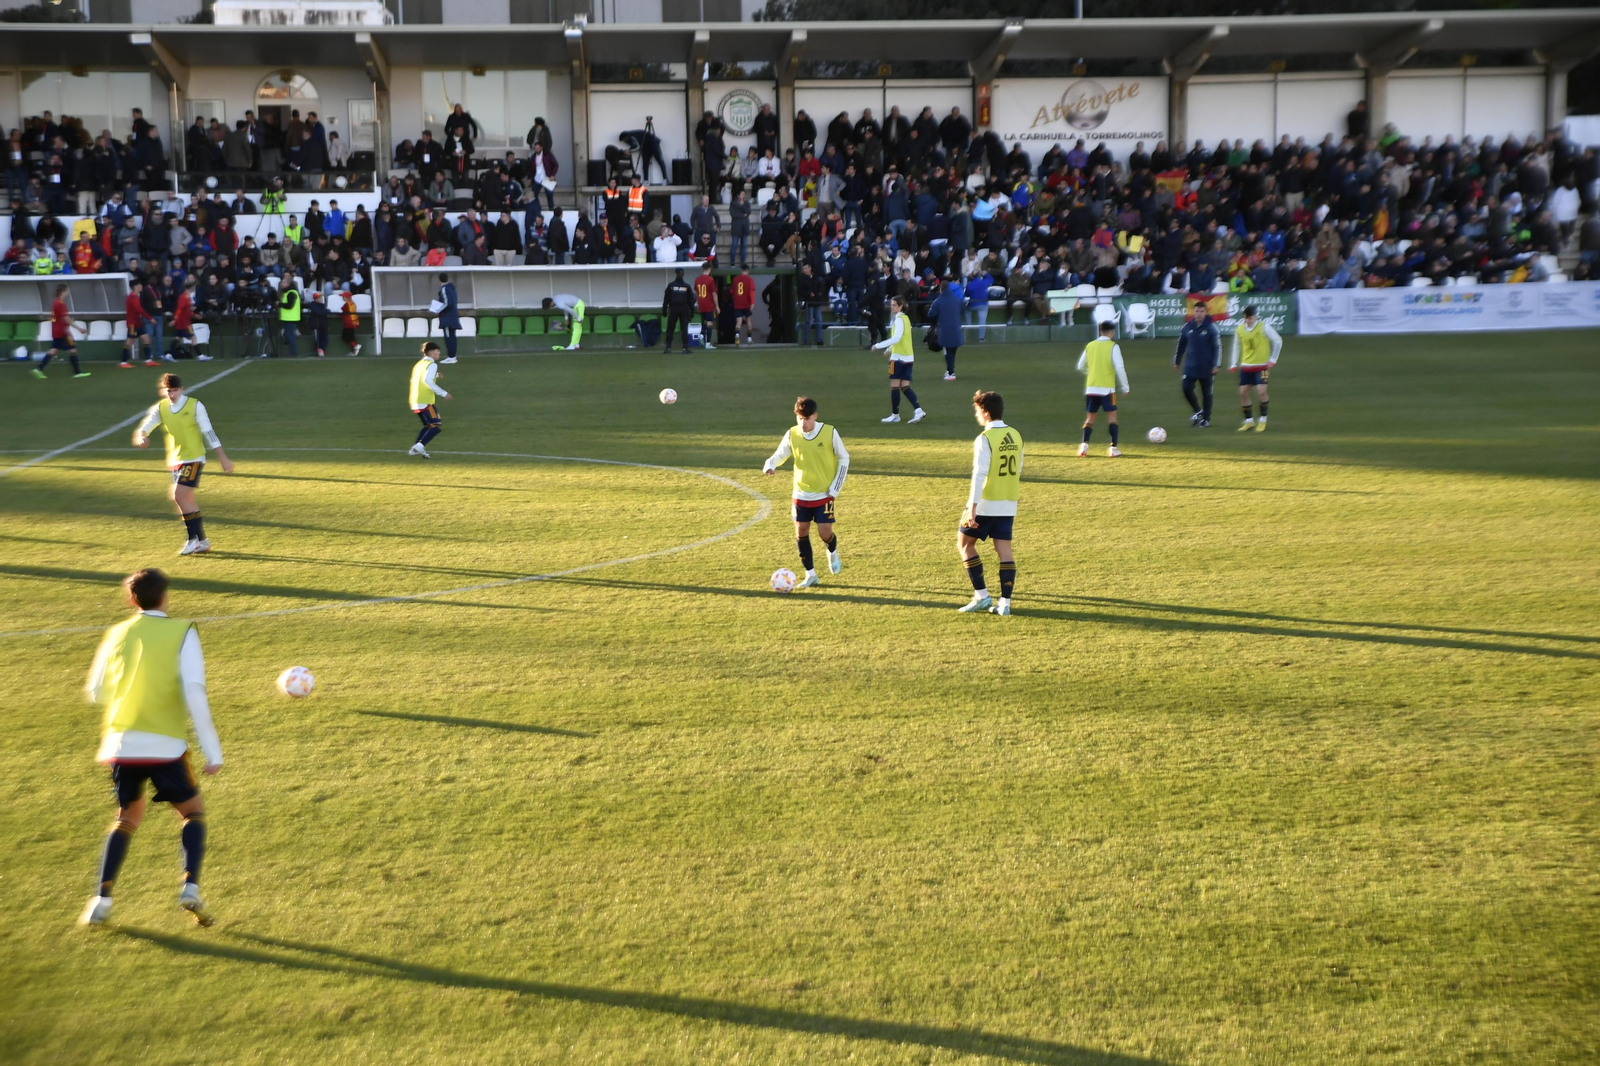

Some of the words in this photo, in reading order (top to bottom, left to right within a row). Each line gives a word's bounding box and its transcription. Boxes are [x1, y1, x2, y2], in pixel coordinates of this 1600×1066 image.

[1030, 81, 1140, 129] Atrévete
[1004, 133, 1016, 141] LA
[1019, 132, 1076, 141] CARIHUELA
[1085, 131, 1164, 140] TORREMOLINOS
[697, 284, 707, 298] 10
[737, 281, 744, 295] 8
[1150, 299, 1183, 307] HOTEL
[1248, 296, 1281, 304] FRUTAS
[1158, 307, 1188, 316] ESPAD
[998, 444, 1019, 452] adidas
[998, 454, 1017, 477] 20
[823, 500, 834, 514] 12
